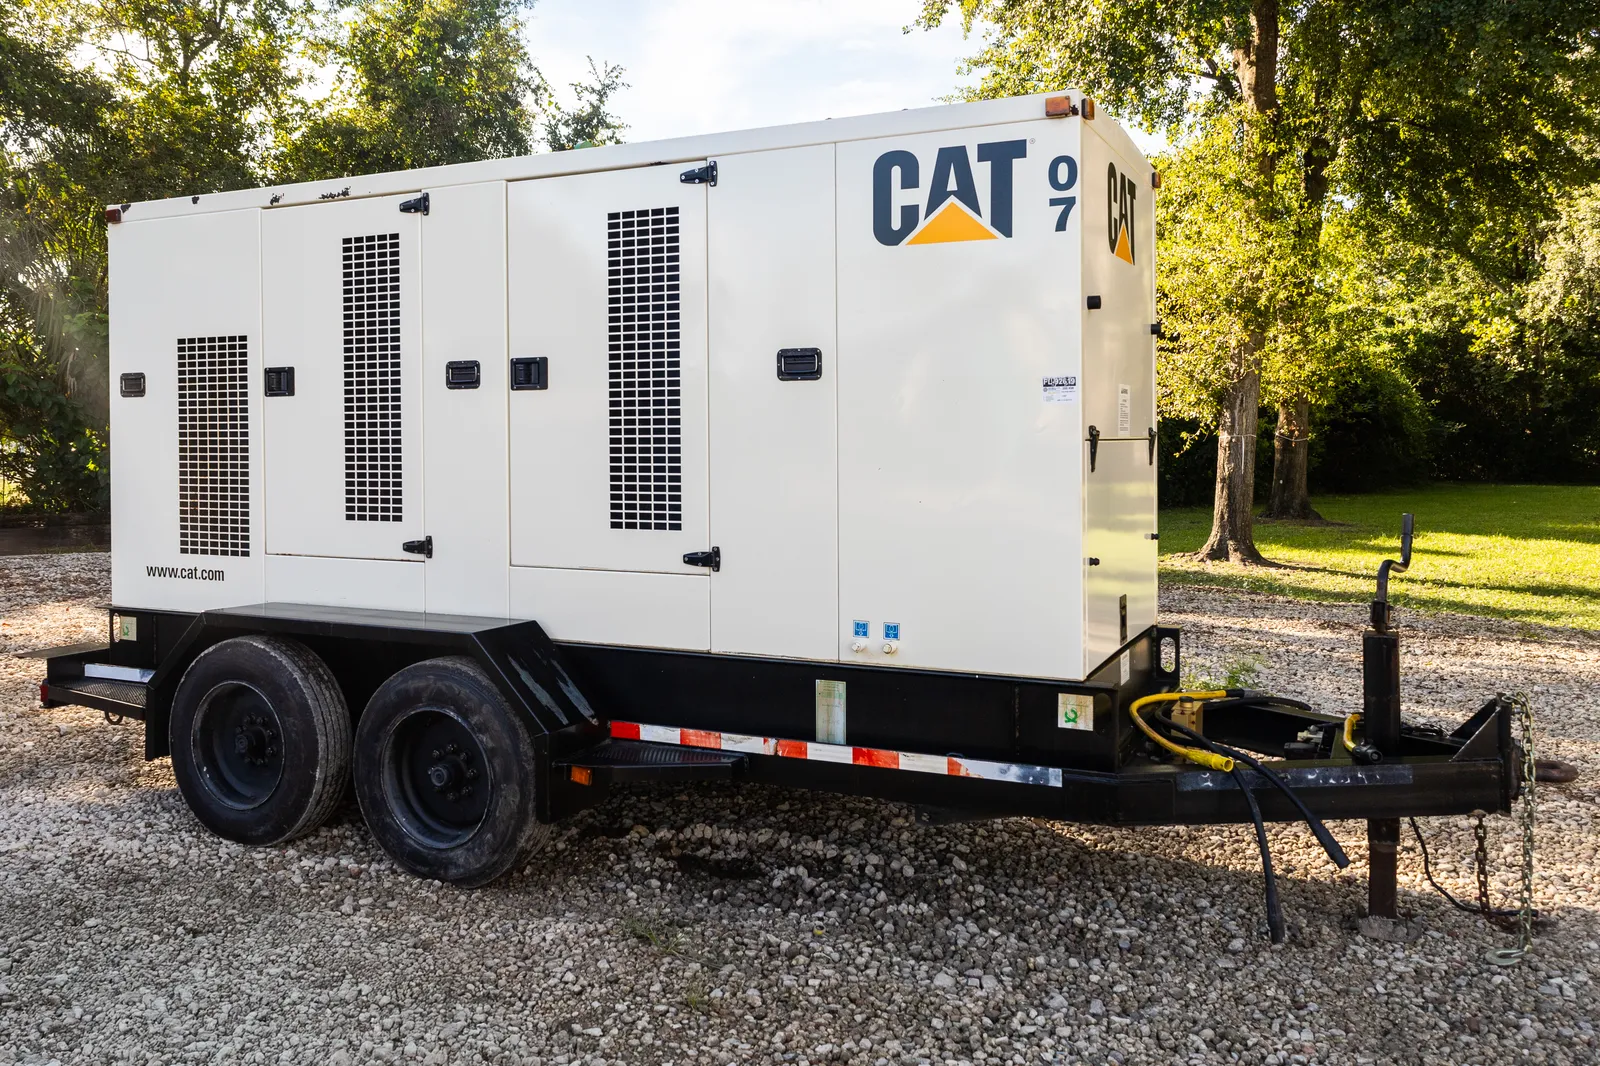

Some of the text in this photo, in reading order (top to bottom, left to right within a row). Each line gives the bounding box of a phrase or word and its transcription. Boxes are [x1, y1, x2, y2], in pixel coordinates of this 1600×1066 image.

[873, 139, 1027, 247] CAT
[1107, 161, 1137, 266] CAT
[146, 565, 225, 582] www.cat.com
